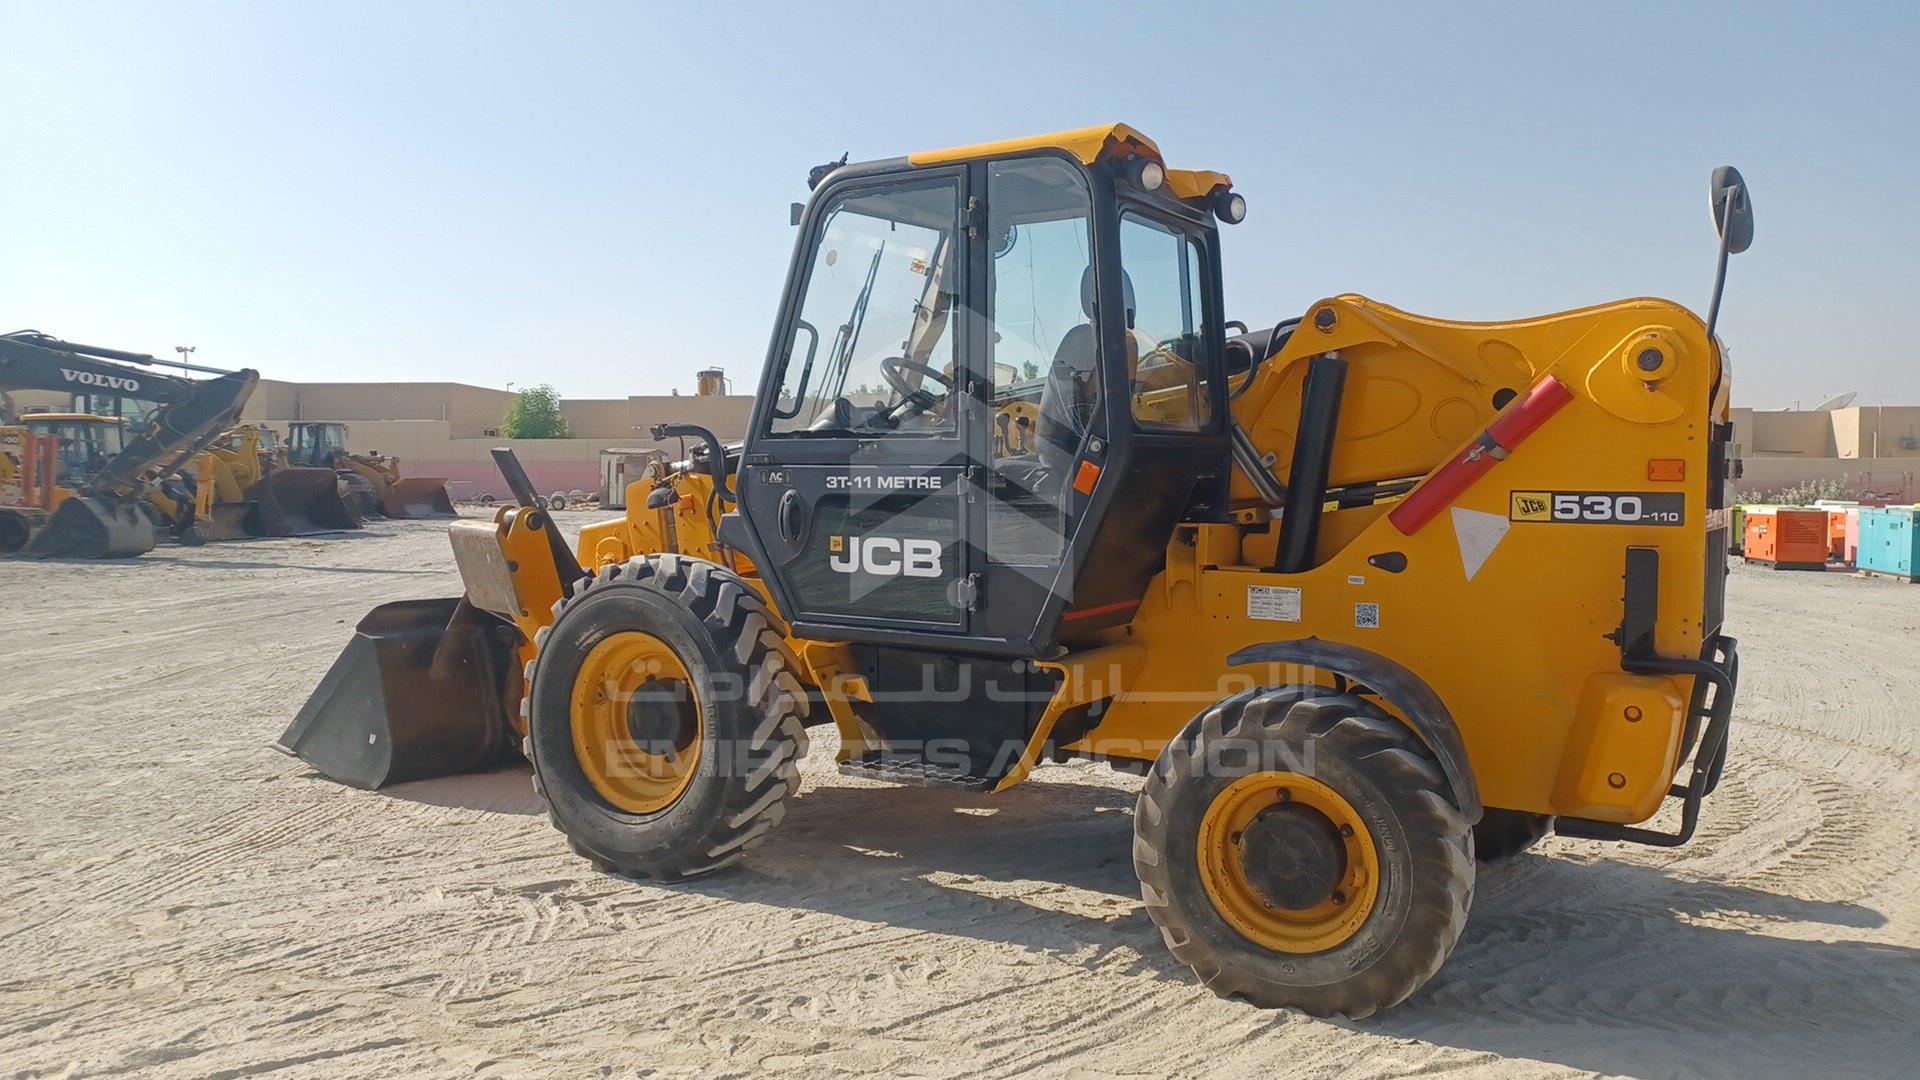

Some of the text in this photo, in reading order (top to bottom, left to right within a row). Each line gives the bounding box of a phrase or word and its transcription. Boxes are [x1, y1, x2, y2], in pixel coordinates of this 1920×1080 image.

[60, 367, 140, 393] VOLVO
[769, 472, 783, 481] AC
[826, 476, 942, 490] 3T-11 METRE
[1521, 498, 1548, 514] JCB
[829, 536, 943, 578] JCB
